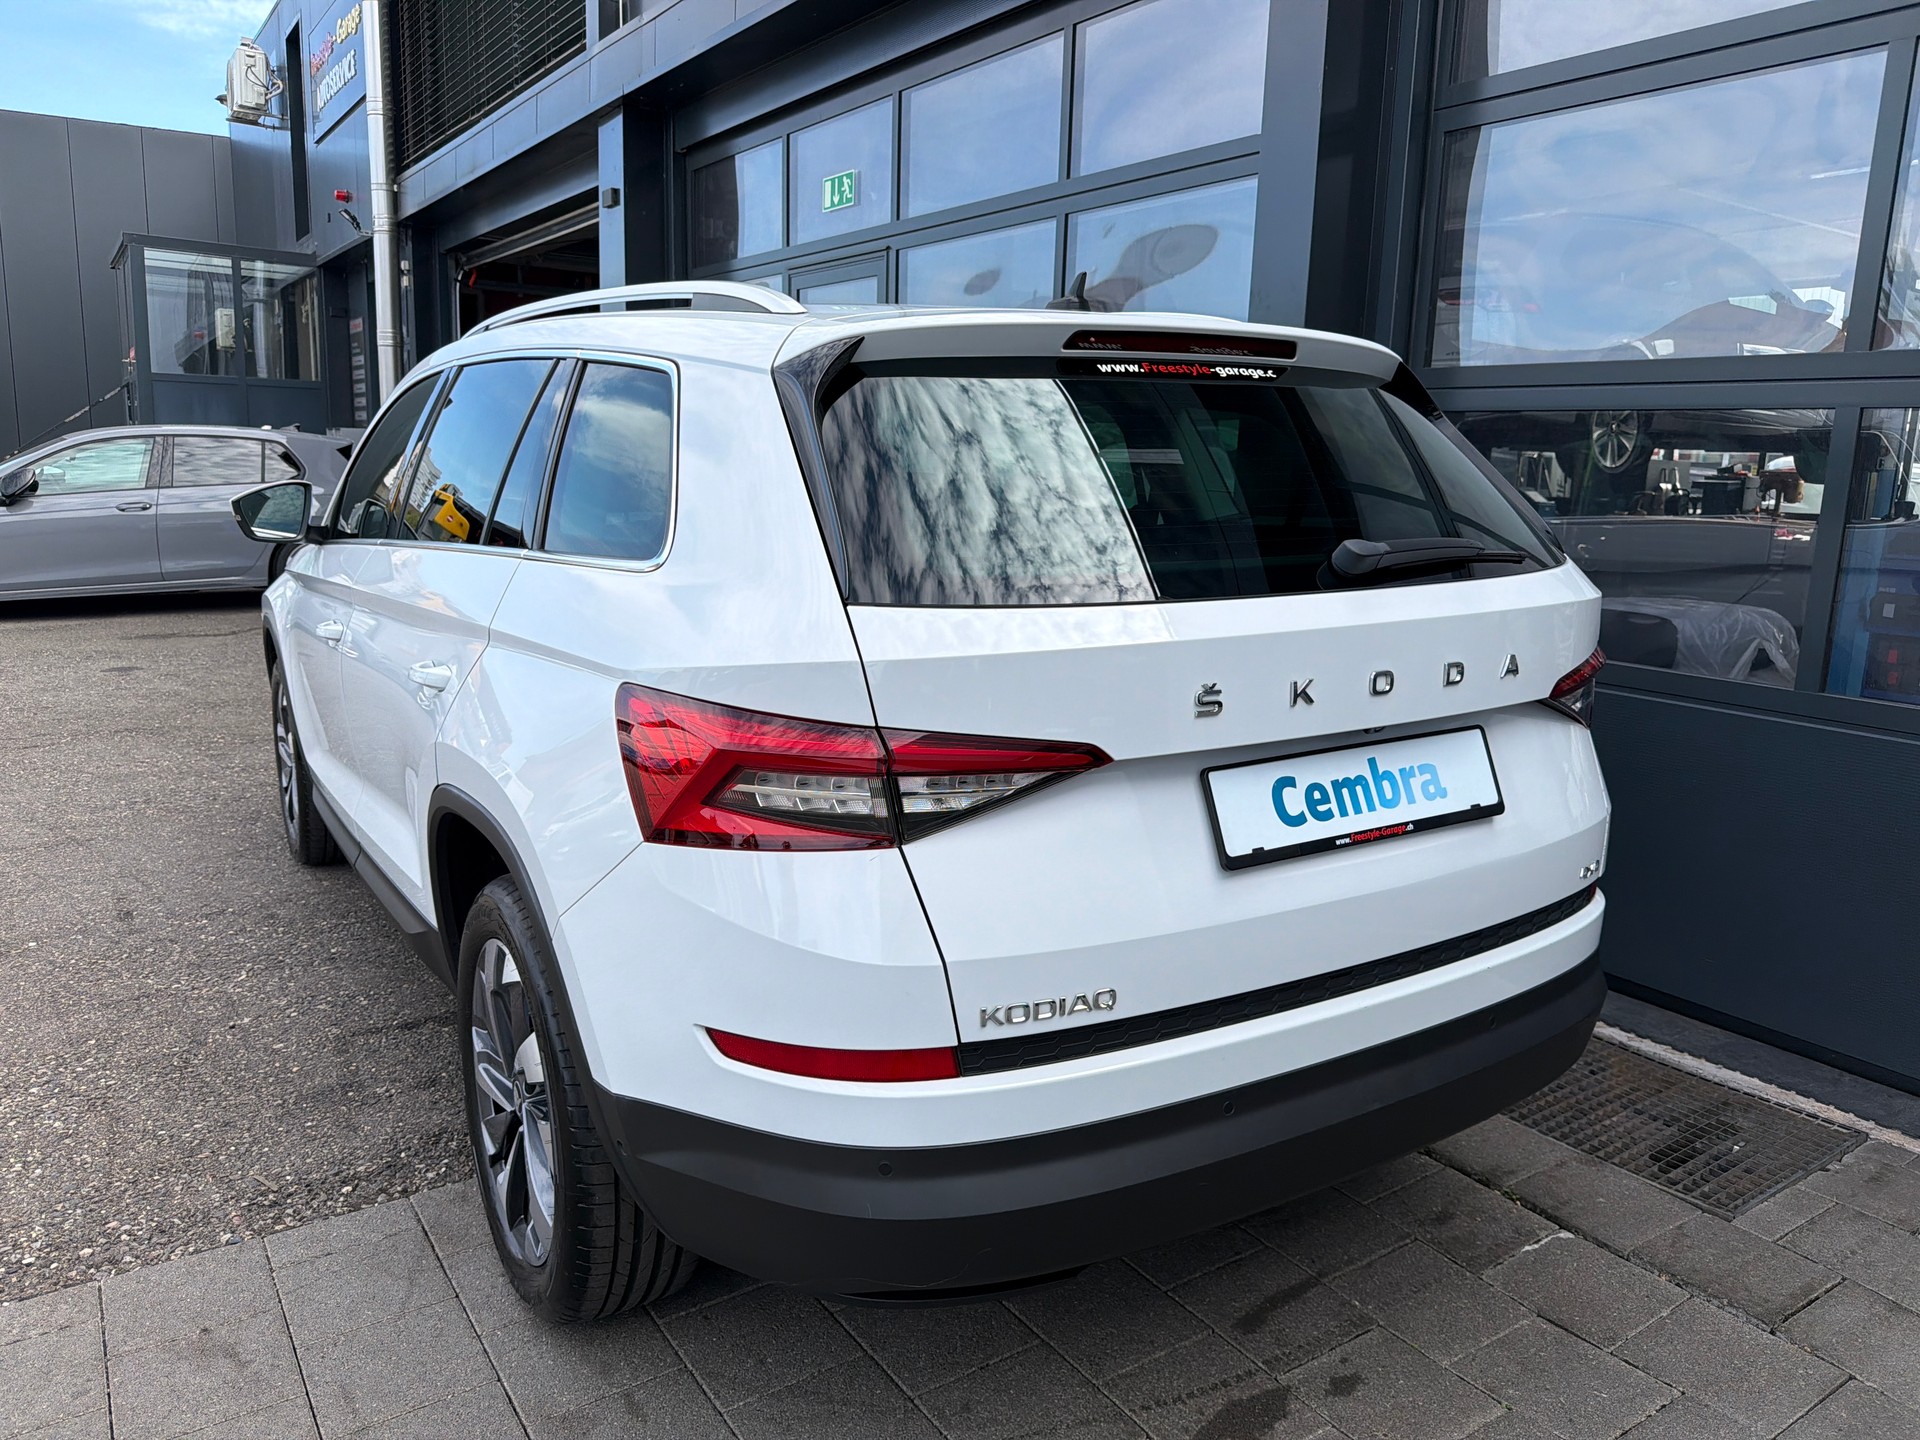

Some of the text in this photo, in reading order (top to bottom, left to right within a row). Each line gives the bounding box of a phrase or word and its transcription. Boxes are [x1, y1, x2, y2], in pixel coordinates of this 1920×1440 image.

[1193, 653, 1520, 719] ŠKODA
[1271, 756, 1448, 828] Cembra
[1335, 822, 1415, 846] www.Freestyle-Garage.ch
[979, 987, 1117, 1028] KODIAQ
